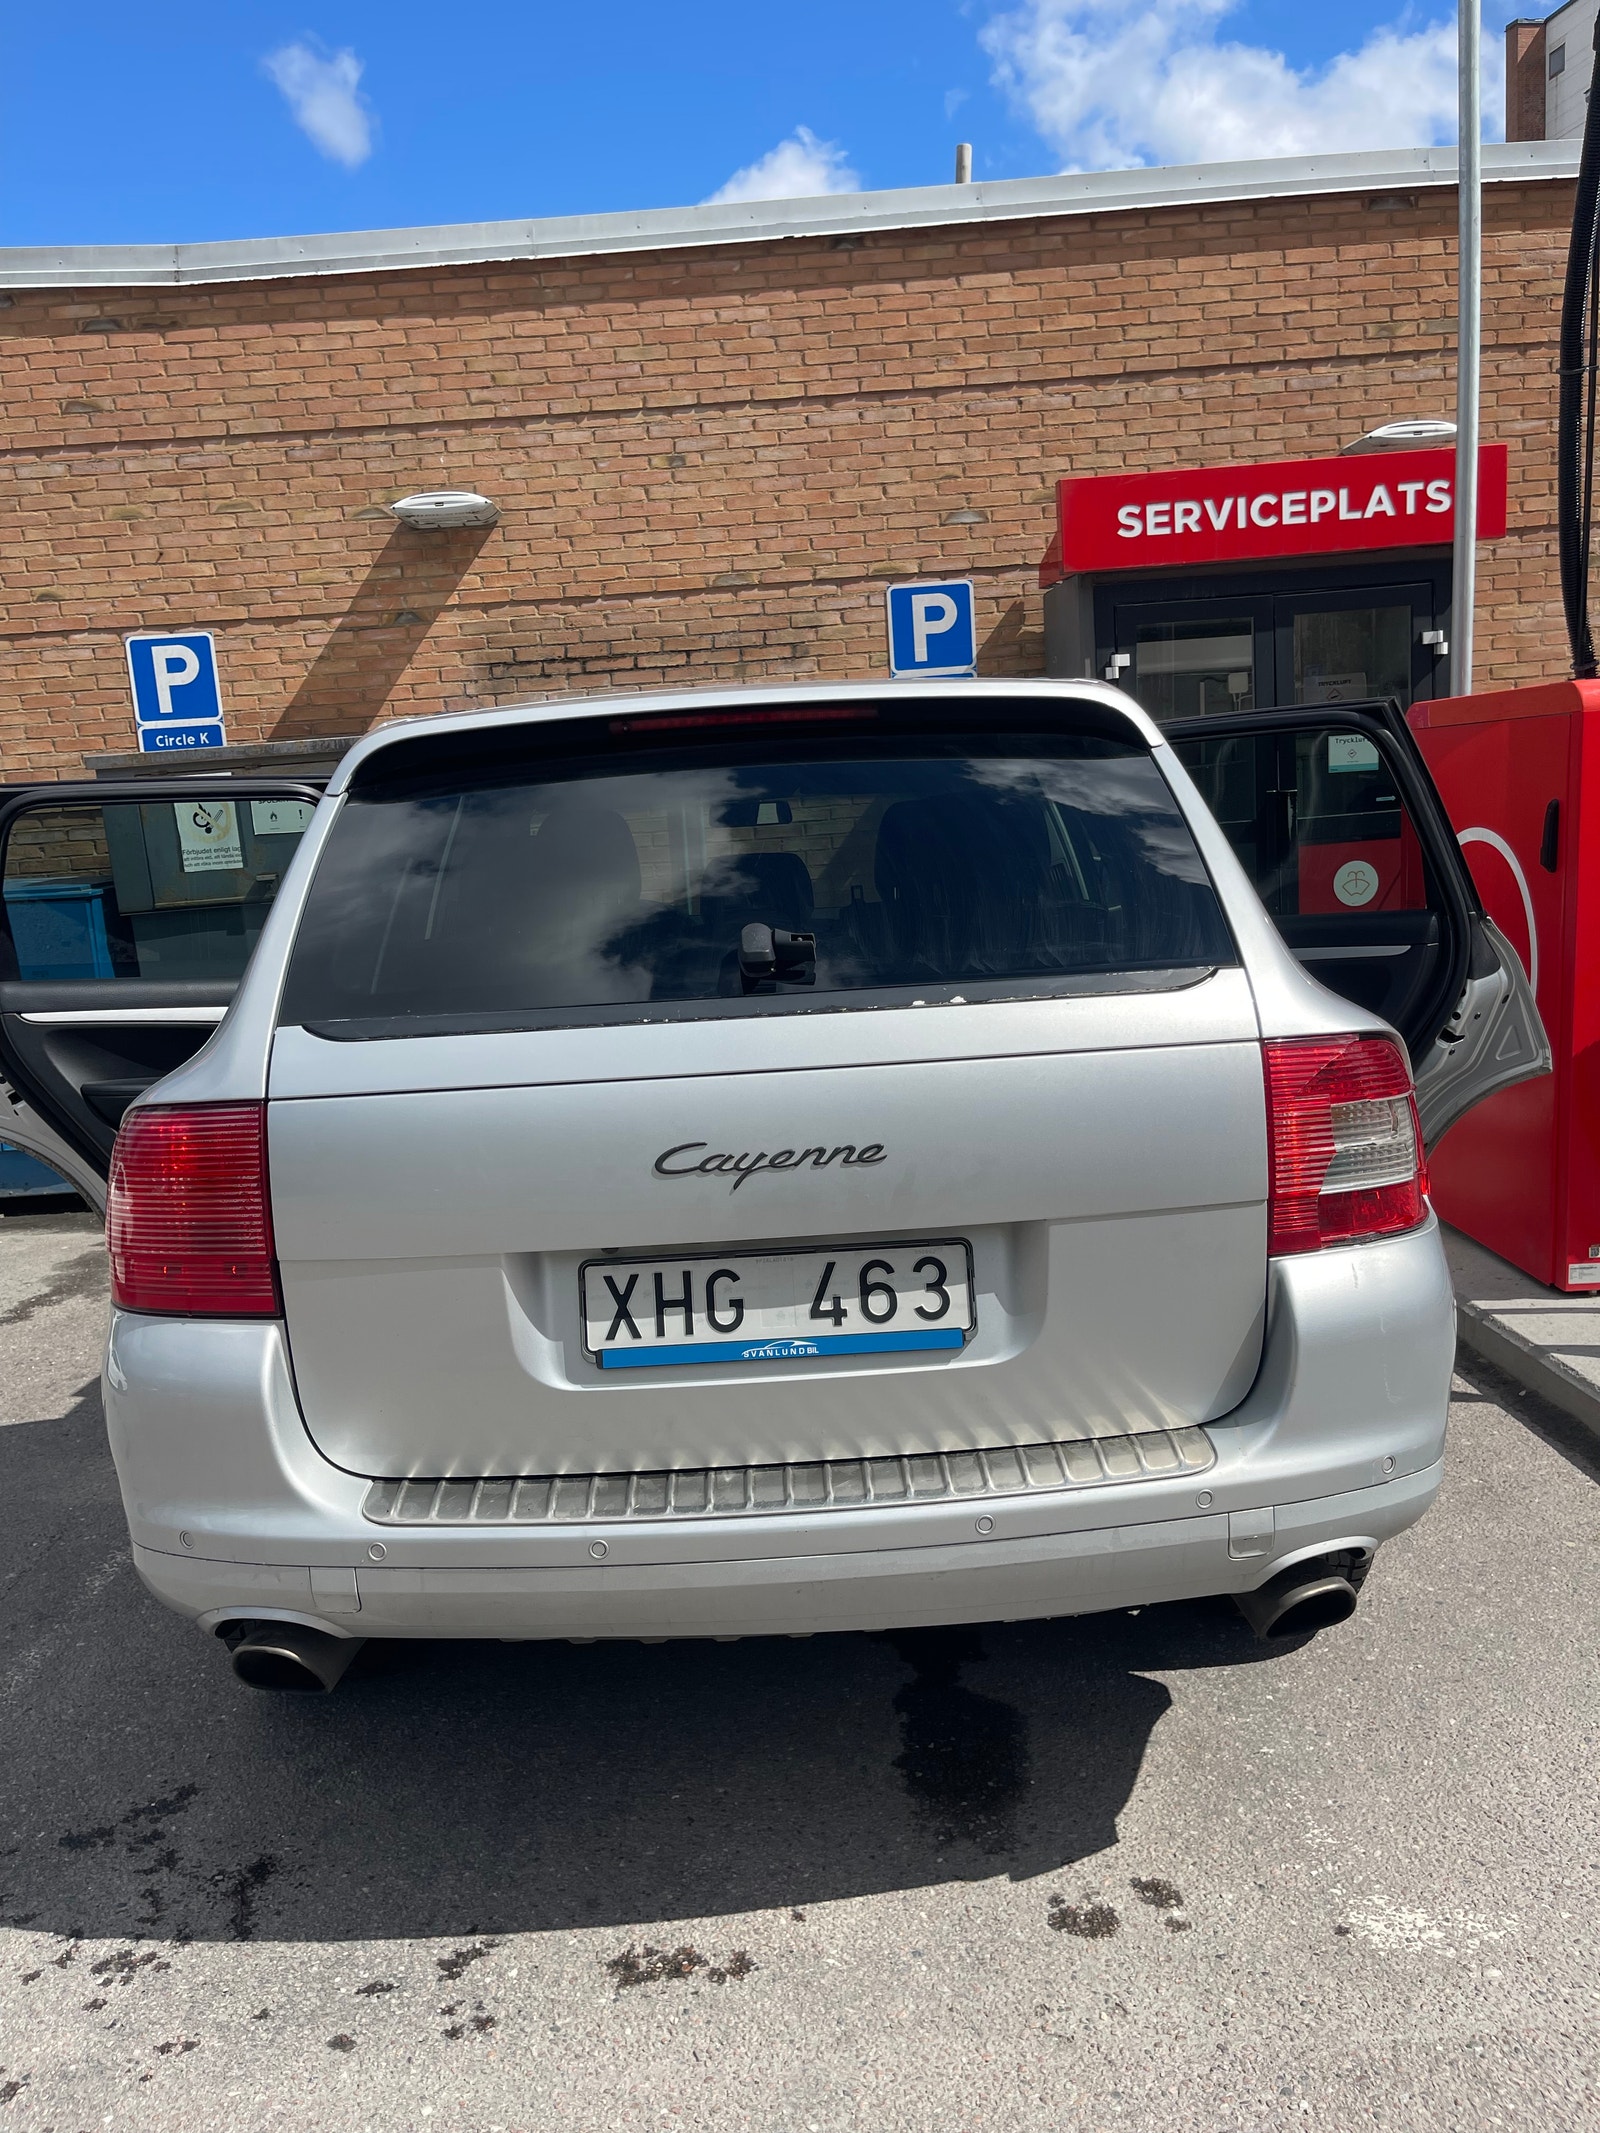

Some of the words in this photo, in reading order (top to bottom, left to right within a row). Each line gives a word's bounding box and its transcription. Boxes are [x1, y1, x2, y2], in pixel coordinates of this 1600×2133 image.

[1117, 479, 1452, 538] SERVICEPLATS
[912, 592, 958, 662] P
[151, 644, 200, 714] P
[156, 733, 195, 747] Circle
[200, 732, 209, 744] K
[182, 848, 213, 856] Förbjudet
[213, 846, 231, 854] enligt
[654, 1141, 888, 1192] Cayenne
[603, 1268, 744, 1341] XHG
[810, 1256, 950, 1327] 463
[743, 1347, 805, 1358] SVANLUND
[806, 1346, 819, 1354] BIL
